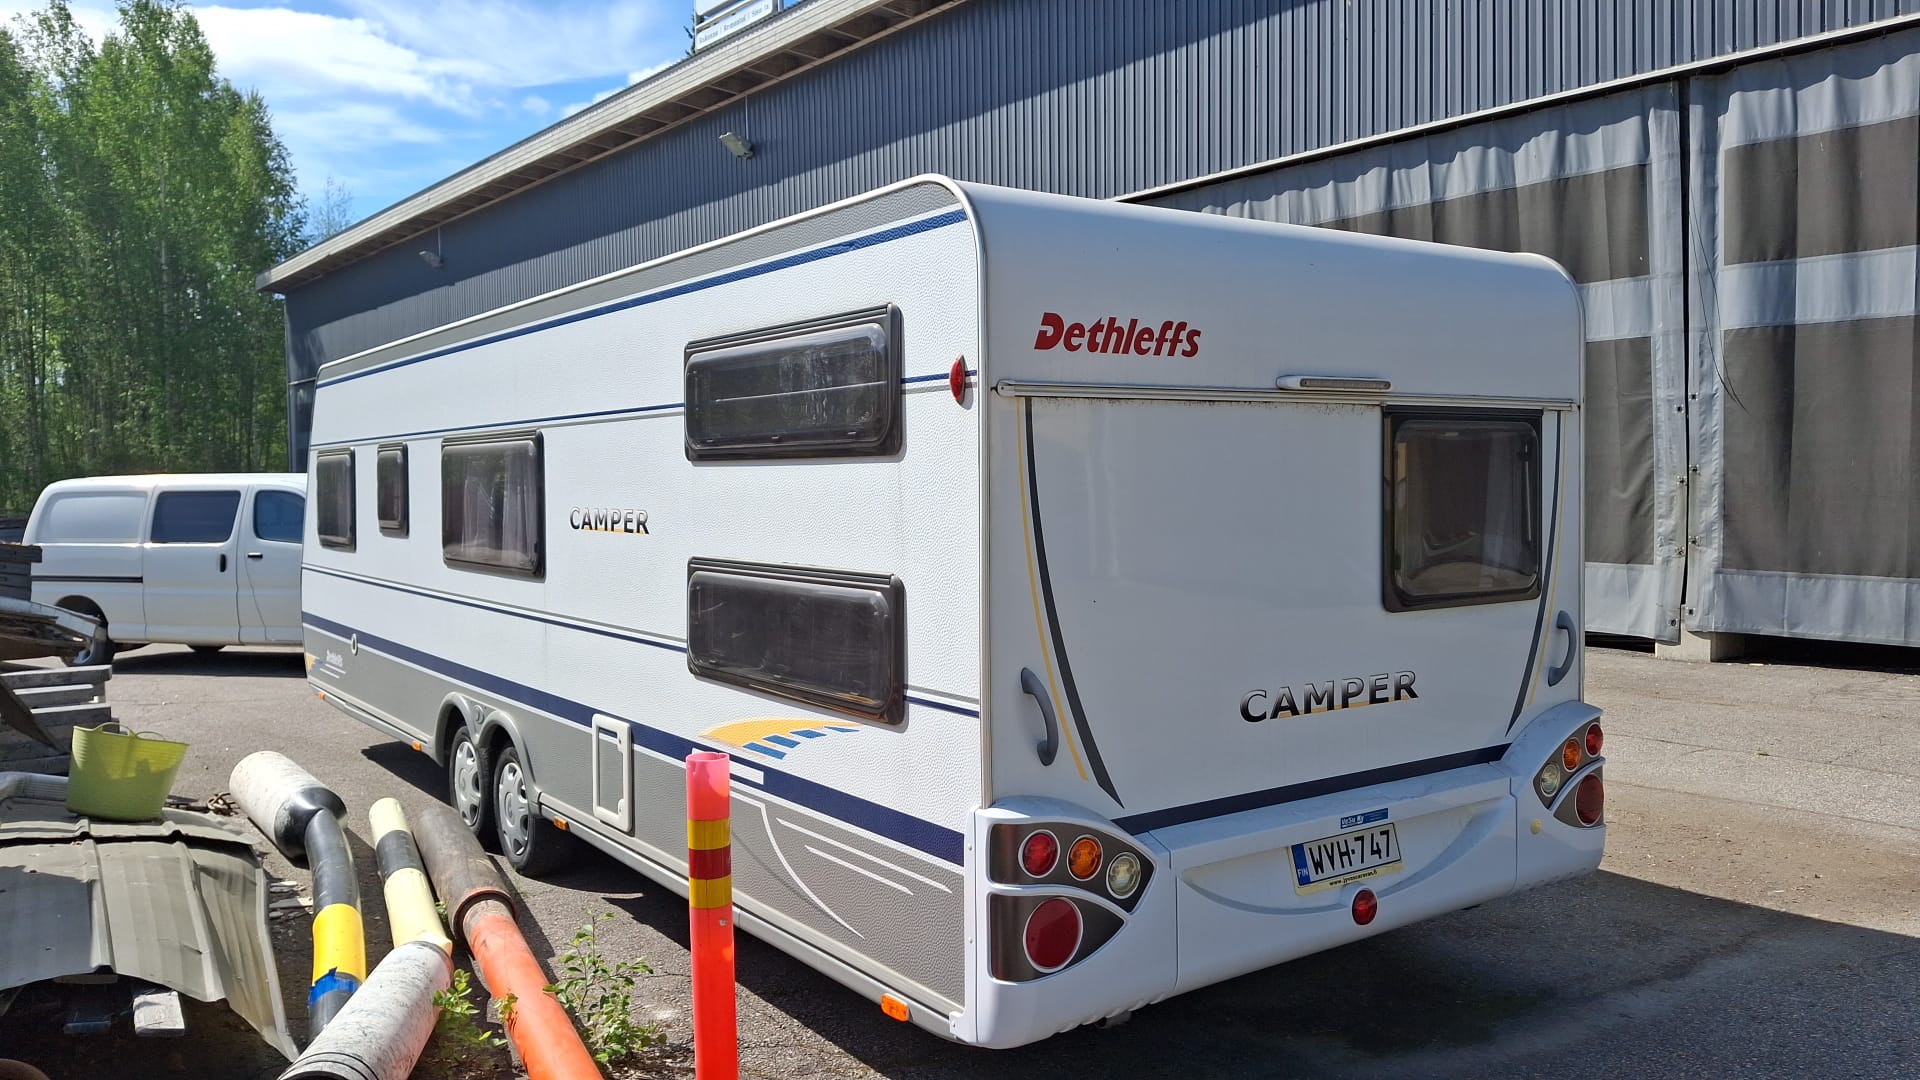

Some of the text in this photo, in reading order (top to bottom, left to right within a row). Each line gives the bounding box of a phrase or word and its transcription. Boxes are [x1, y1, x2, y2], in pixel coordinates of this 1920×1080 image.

[1034, 312, 1201, 358] Dethleffs
[569, 507, 649, 534] CAMPER
[1240, 670, 1419, 722] CAMPER
[1297, 867, 1309, 879] FIN
[1308, 830, 1390, 875] WVH-747
